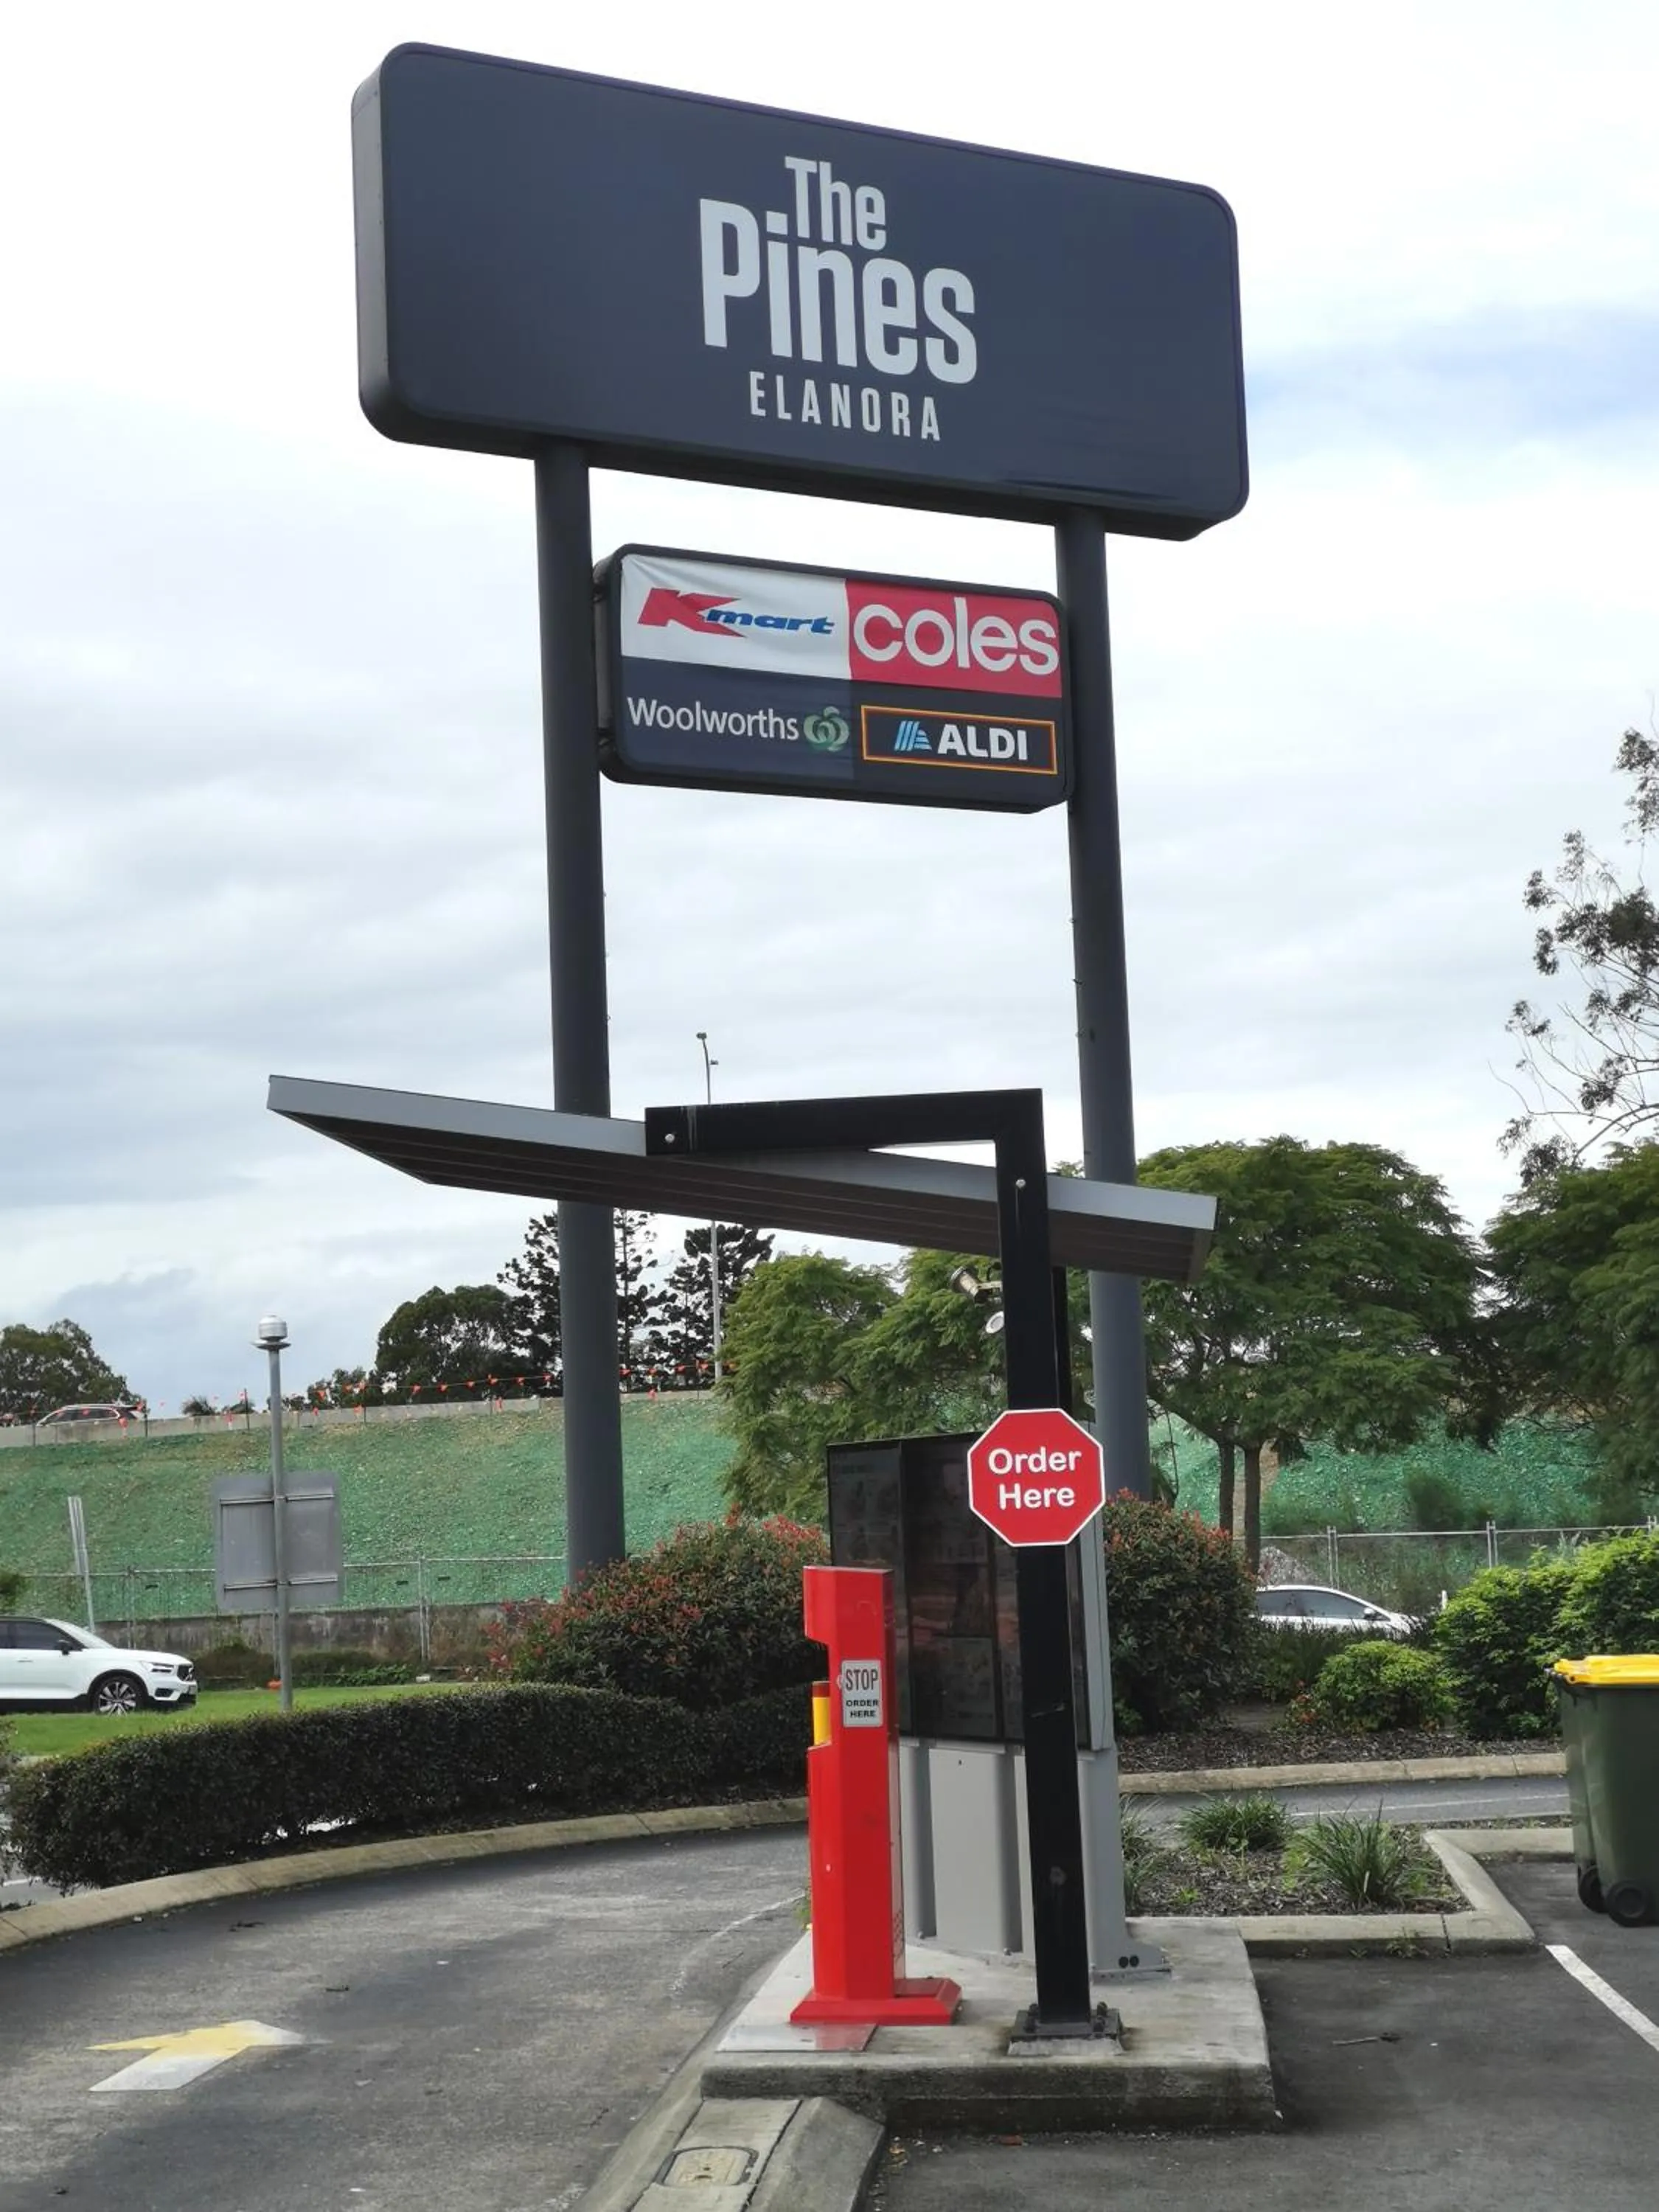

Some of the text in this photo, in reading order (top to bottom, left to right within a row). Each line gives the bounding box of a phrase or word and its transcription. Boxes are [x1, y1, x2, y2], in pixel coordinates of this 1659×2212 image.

[785, 156, 886, 251] The
[700, 198, 978, 384] Pines
[749, 371, 941, 442] ELANORA
[636, 588, 835, 639] Kmart
[853, 597, 1060, 675] coles
[627, 697, 799, 741] Woolworths
[937, 725, 1028, 761] ALDI
[988, 1446, 1082, 1475] Order
[998, 1483, 1076, 1510] Here
[845, 1669, 879, 1691] STOP
[846, 1698, 879, 1707] ORDER
[850, 1709, 877, 1718] HERE
